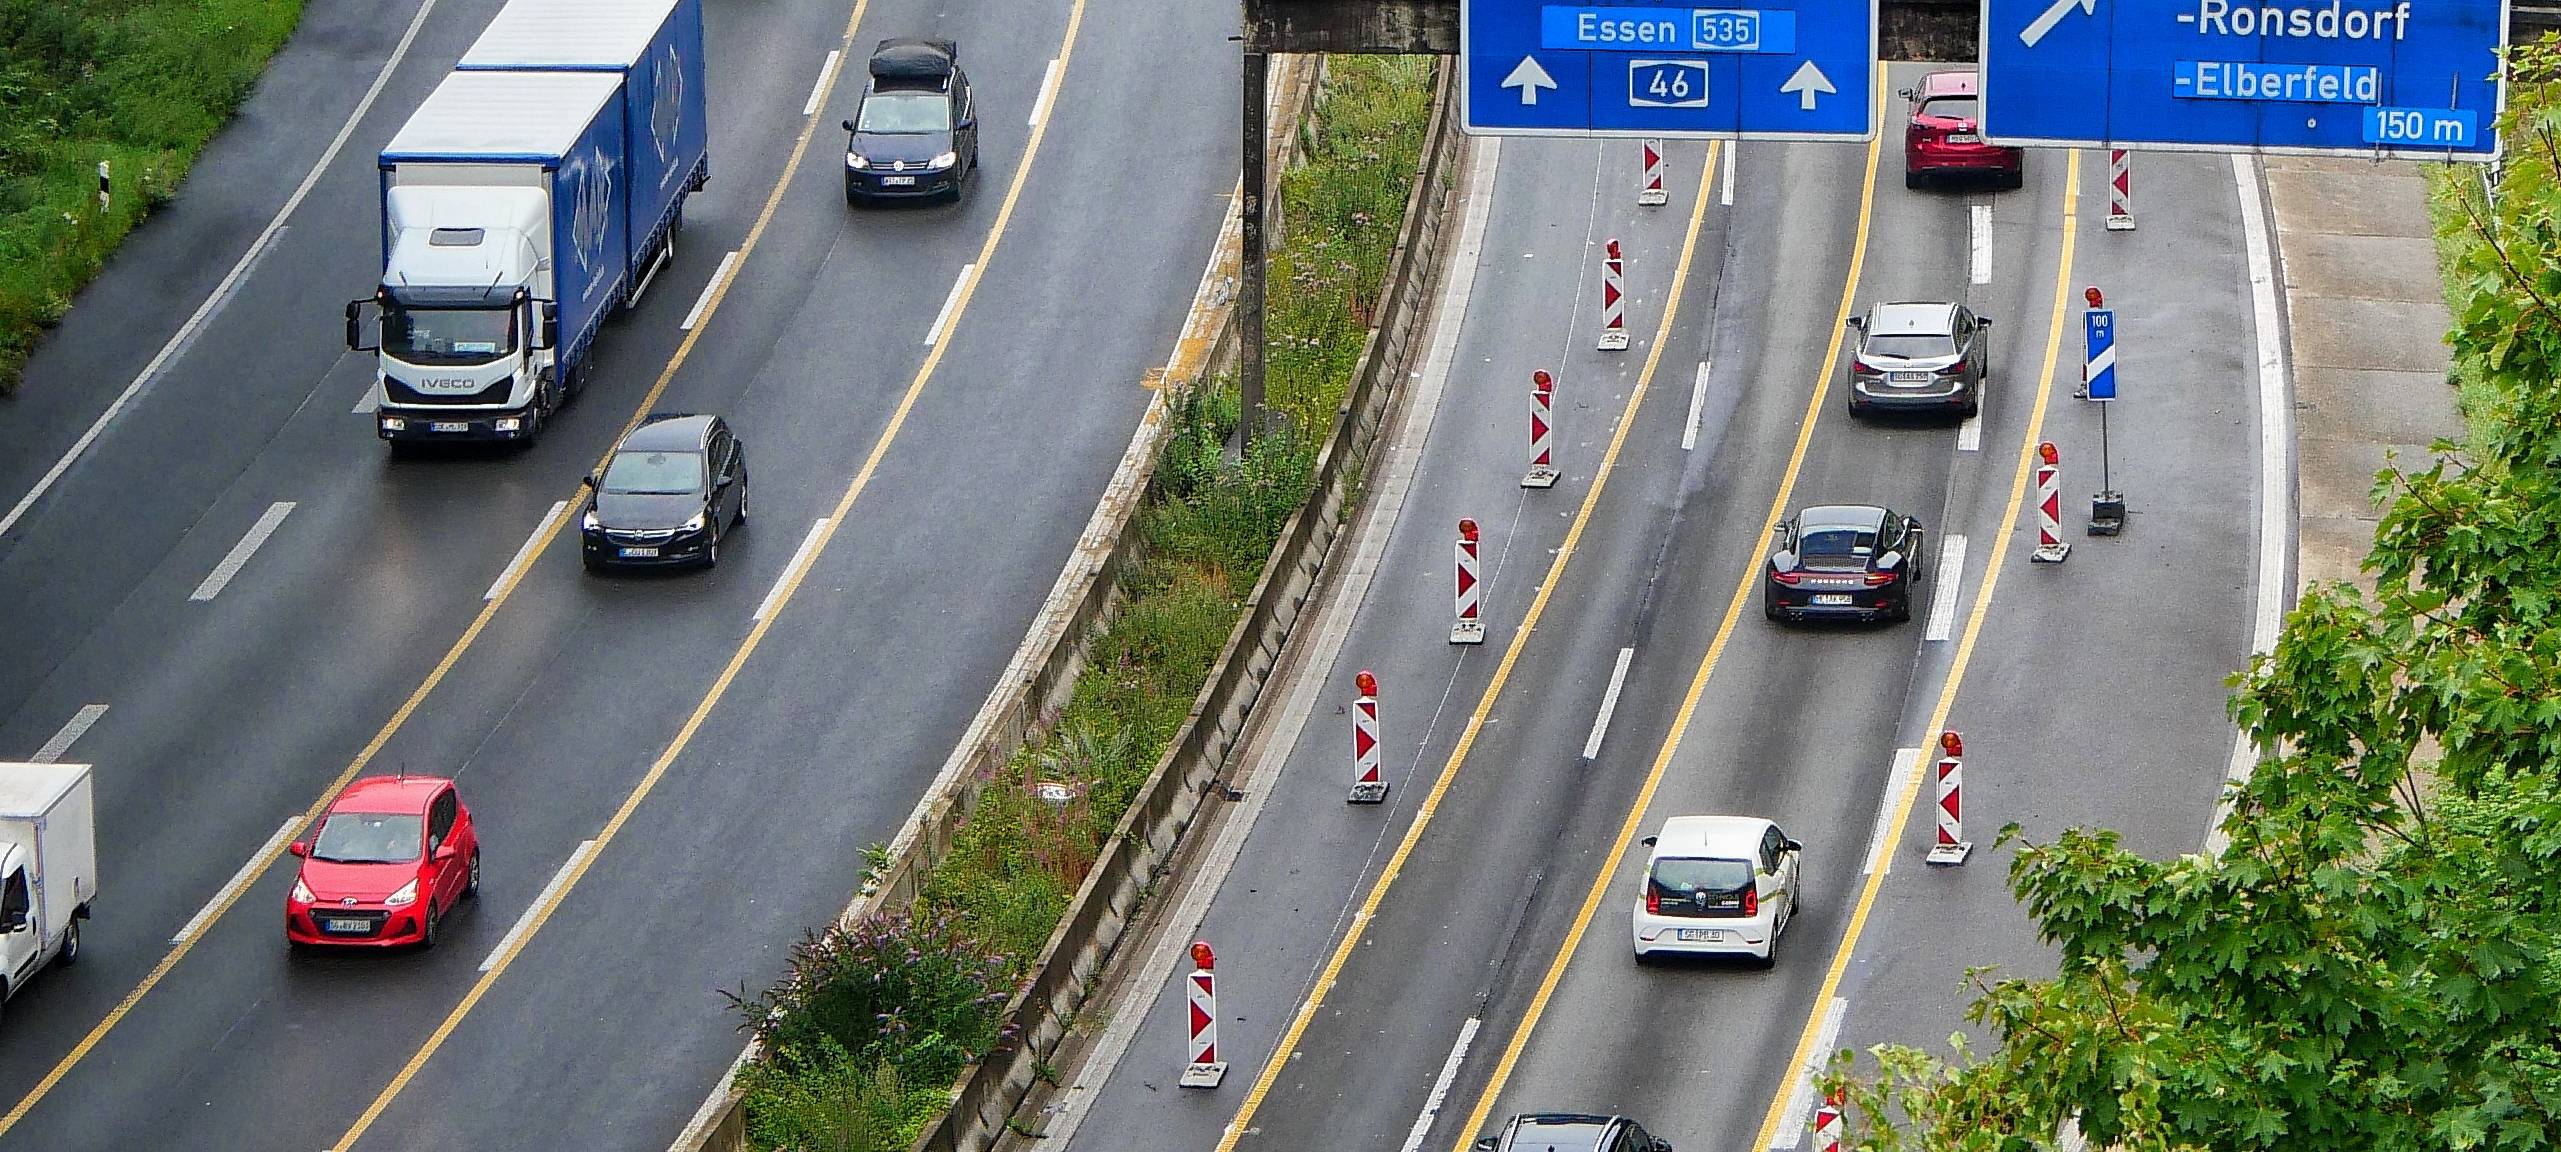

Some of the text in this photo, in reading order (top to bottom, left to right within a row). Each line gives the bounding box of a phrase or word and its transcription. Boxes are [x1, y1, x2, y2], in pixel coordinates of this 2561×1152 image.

[1578, 13, 1750, 43] Essen 535
[2177, 0, 2410, 40] -Ronsdorf
[1648, 69, 1690, 97] 46
[2176, 62, 2377, 101] -Elberfeld
[2377, 112, 2463, 141] 150 m
[2092, 315, 2108, 327] 100
[2096, 330, 2105, 338] m
[421, 378, 475, 389] IVECO
